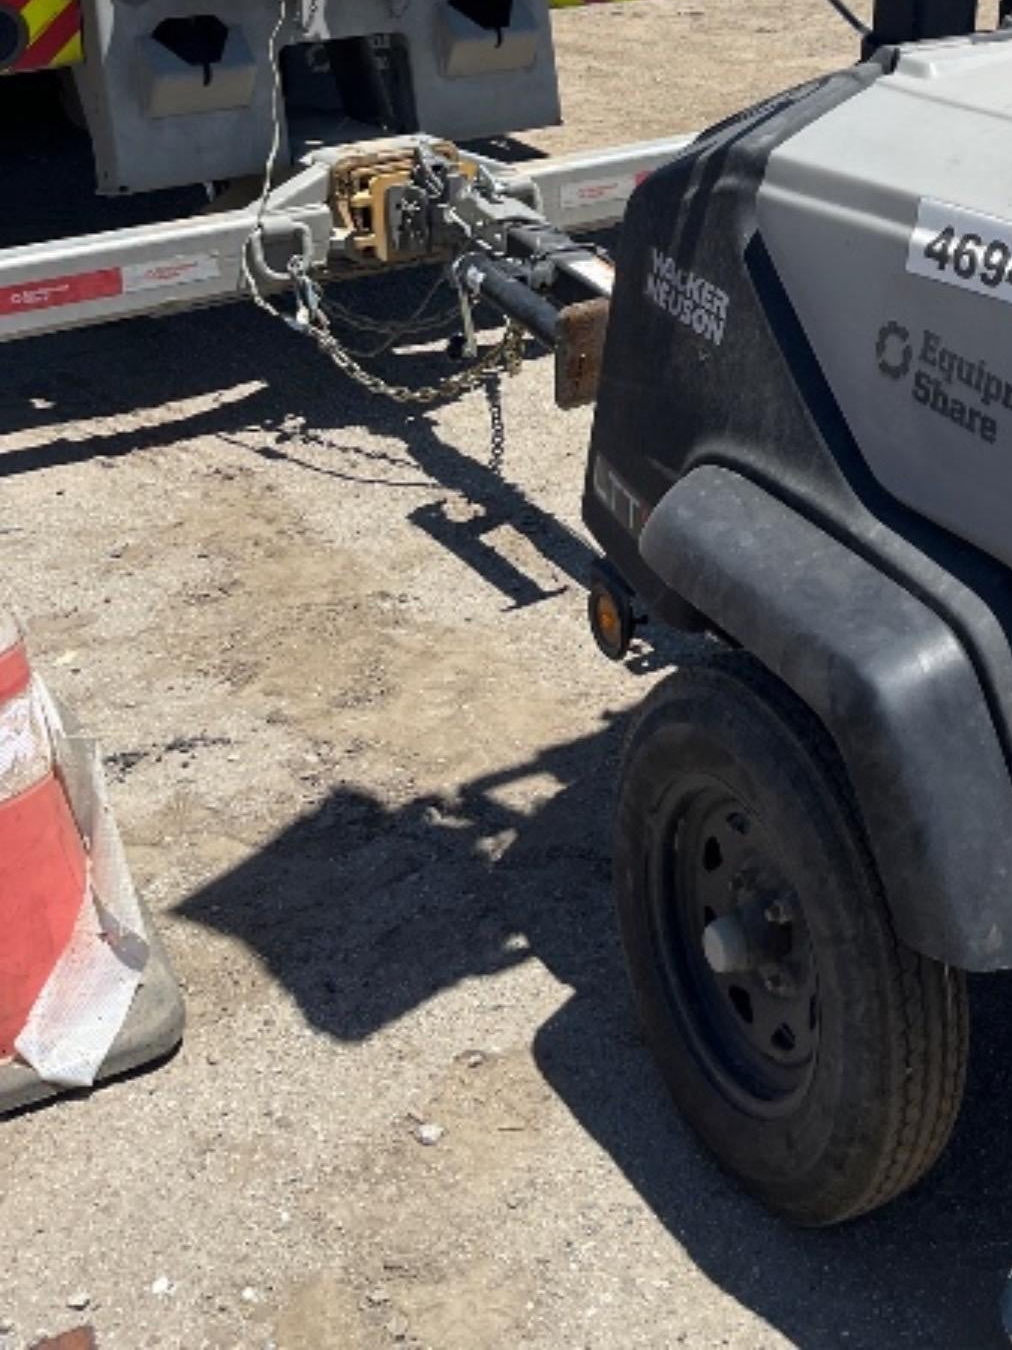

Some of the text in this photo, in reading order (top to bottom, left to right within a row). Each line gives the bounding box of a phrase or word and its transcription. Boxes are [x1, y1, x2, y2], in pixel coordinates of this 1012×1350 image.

[646, 273, 725, 346] NEUSON
[652, 248, 729, 319] WACKER
[912, 369, 997, 445] Share
